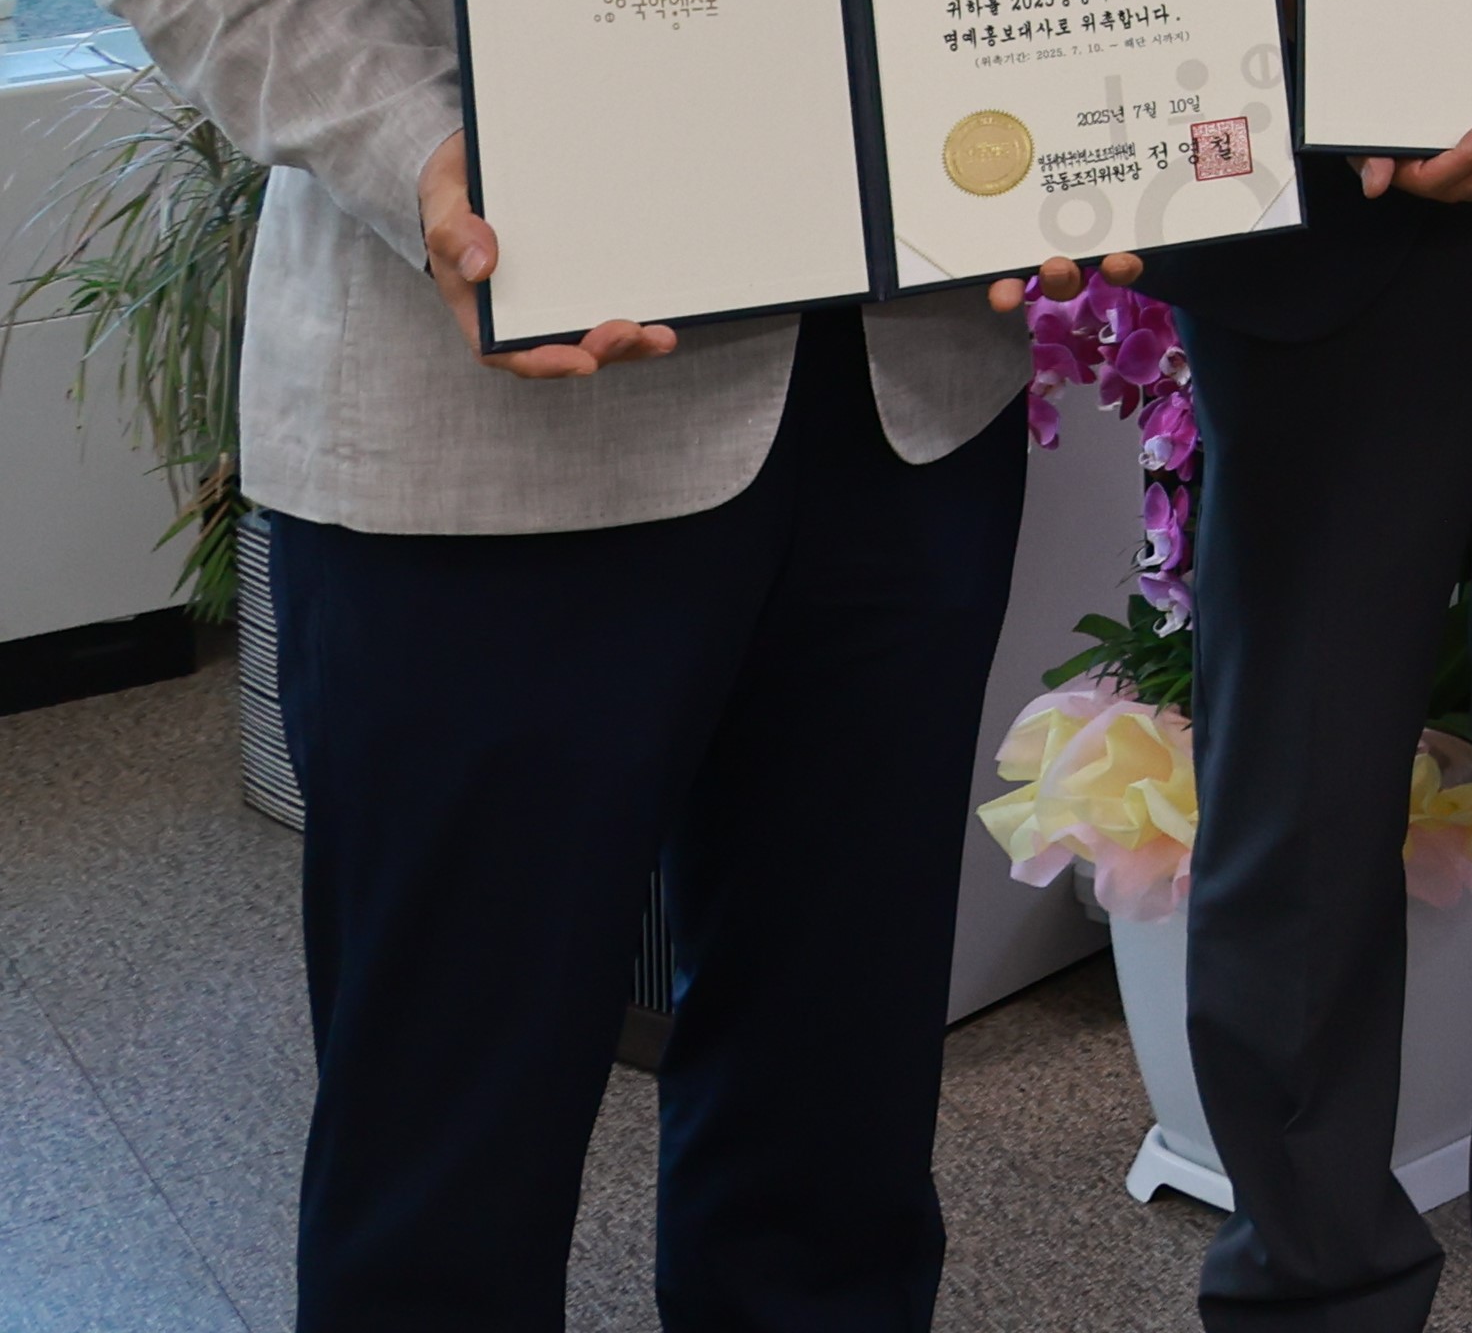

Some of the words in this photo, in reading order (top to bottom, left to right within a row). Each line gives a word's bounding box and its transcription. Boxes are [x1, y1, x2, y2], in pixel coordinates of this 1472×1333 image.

[943, 19, 1072, 52] 명예홍보대사로
[1081, 4, 1182, 33] 위촉합니다.
[1077, 106, 1125, 127] 2025년
[1133, 100, 1157, 119] 7월
[1169, 95, 1201, 114] 10일
[1041, 163, 1143, 193] 공동조직위원장
[1148, 141, 1169, 170] 정
[1178, 137, 1199, 165] 영
[1211, 133, 1233, 161] 철
